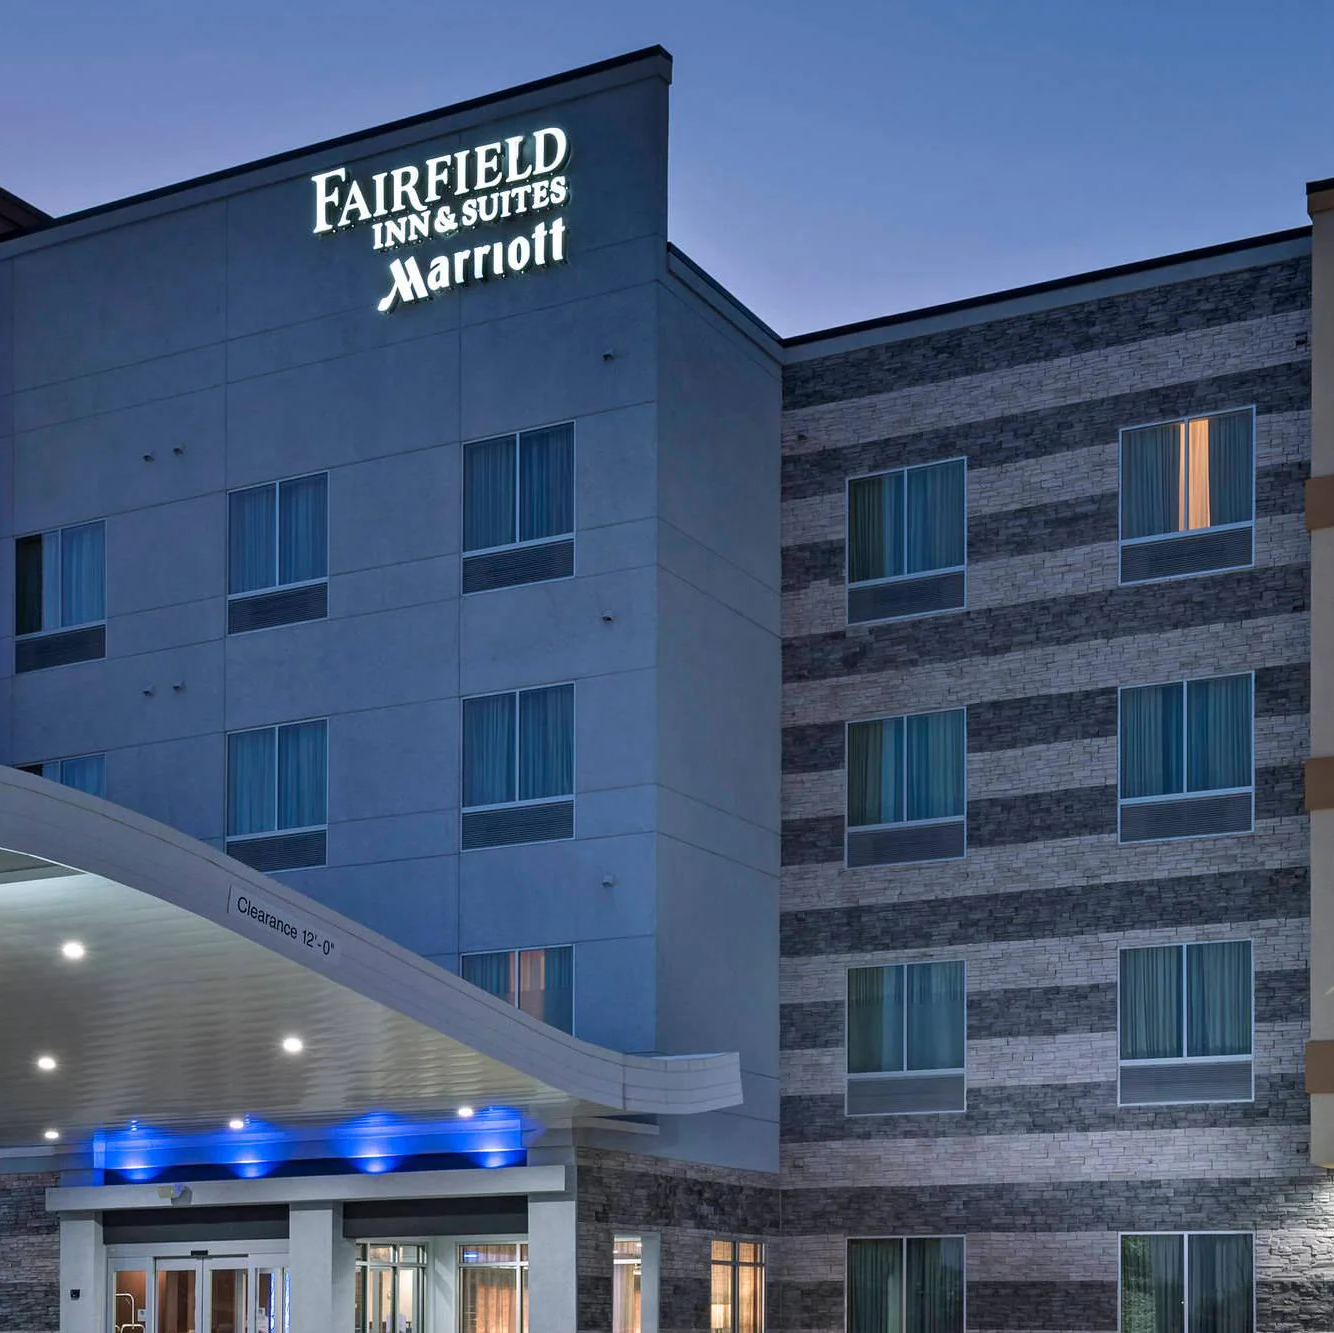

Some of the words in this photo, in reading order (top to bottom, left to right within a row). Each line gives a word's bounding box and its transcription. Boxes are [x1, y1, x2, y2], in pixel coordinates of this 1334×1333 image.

[311, 127, 568, 234] FAIRFIELD
[371, 210, 431, 250] INN
[434, 205, 457, 234] &
[461, 175, 567, 226] SUITES
[376, 216, 566, 312] Marriott
[237, 896, 298, 939] Clearance
